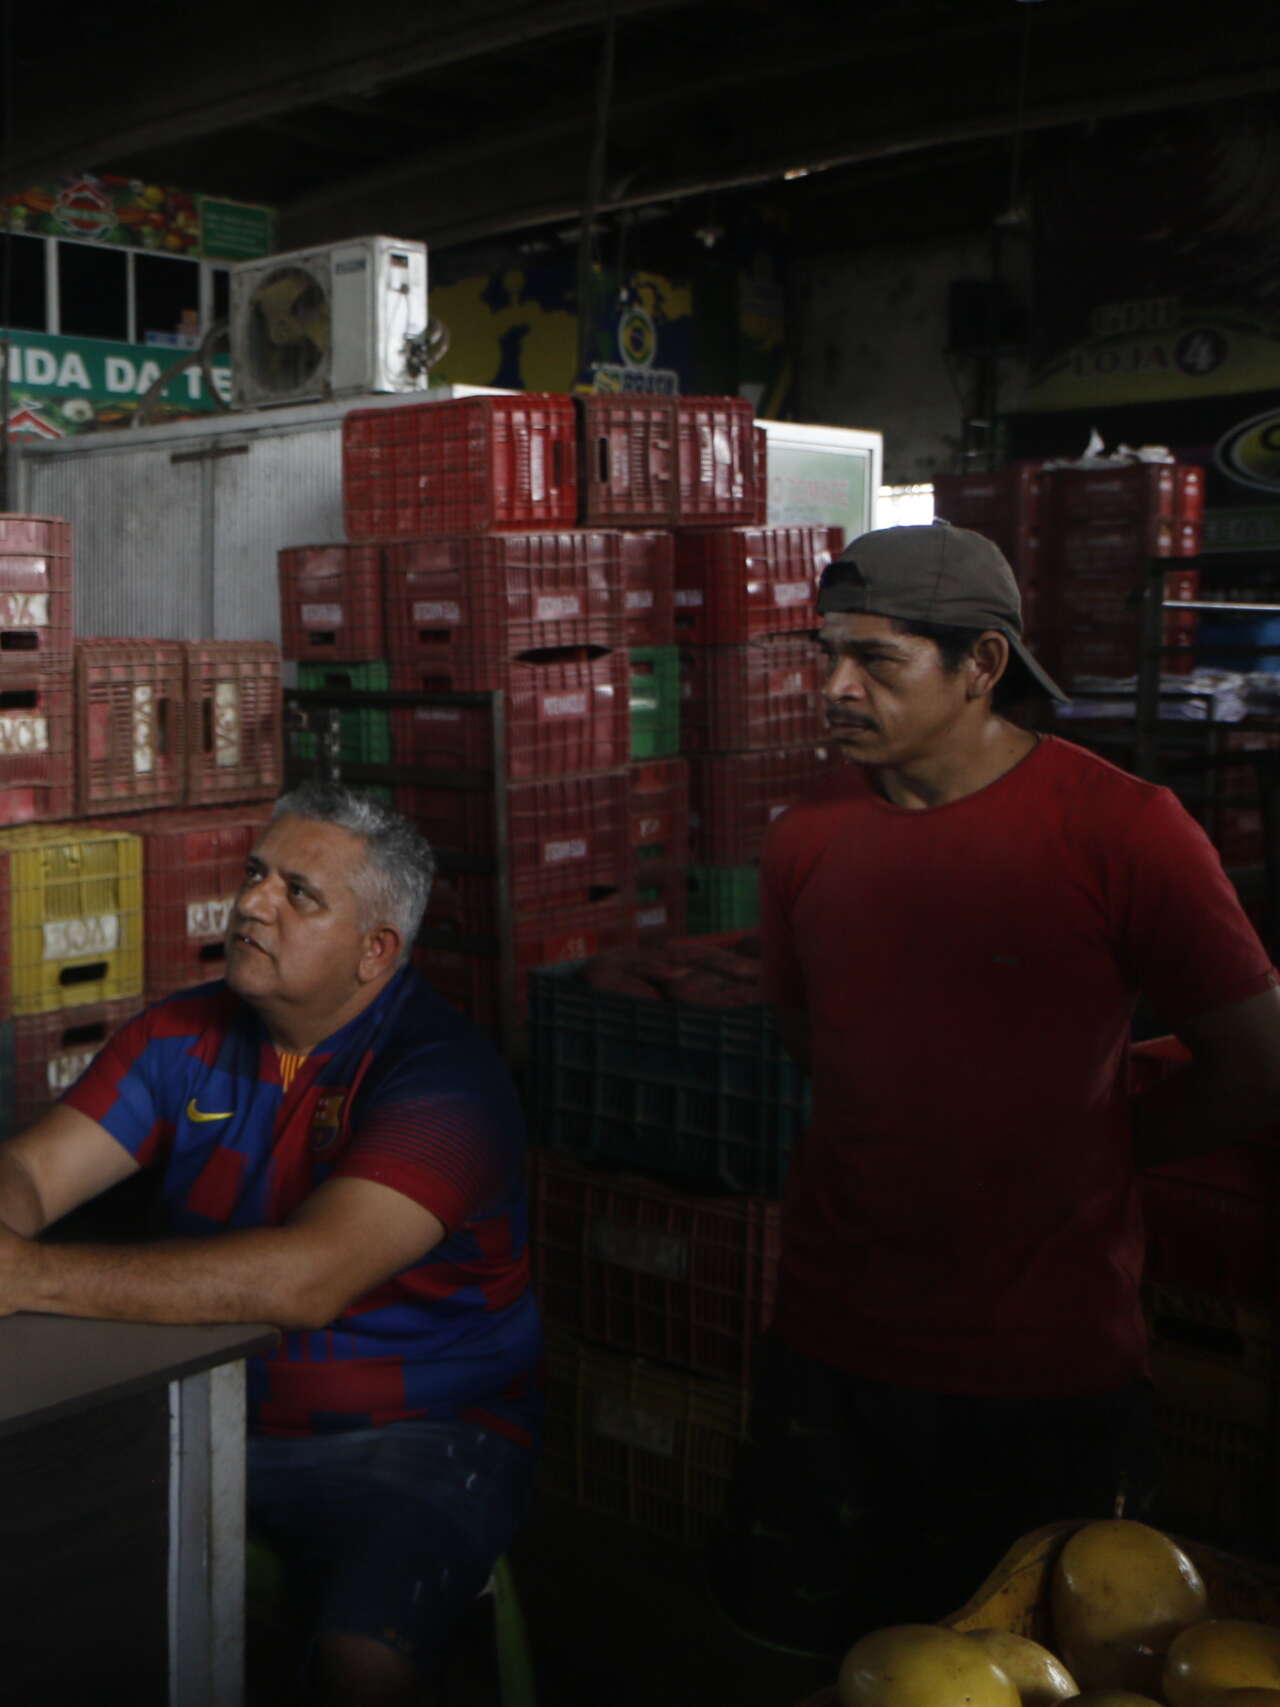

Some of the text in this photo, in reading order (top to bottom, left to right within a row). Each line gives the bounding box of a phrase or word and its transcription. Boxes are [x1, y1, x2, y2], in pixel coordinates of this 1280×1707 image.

[1073, 334, 1216, 377] LOJA 4
[183, 364, 232, 402] TE
